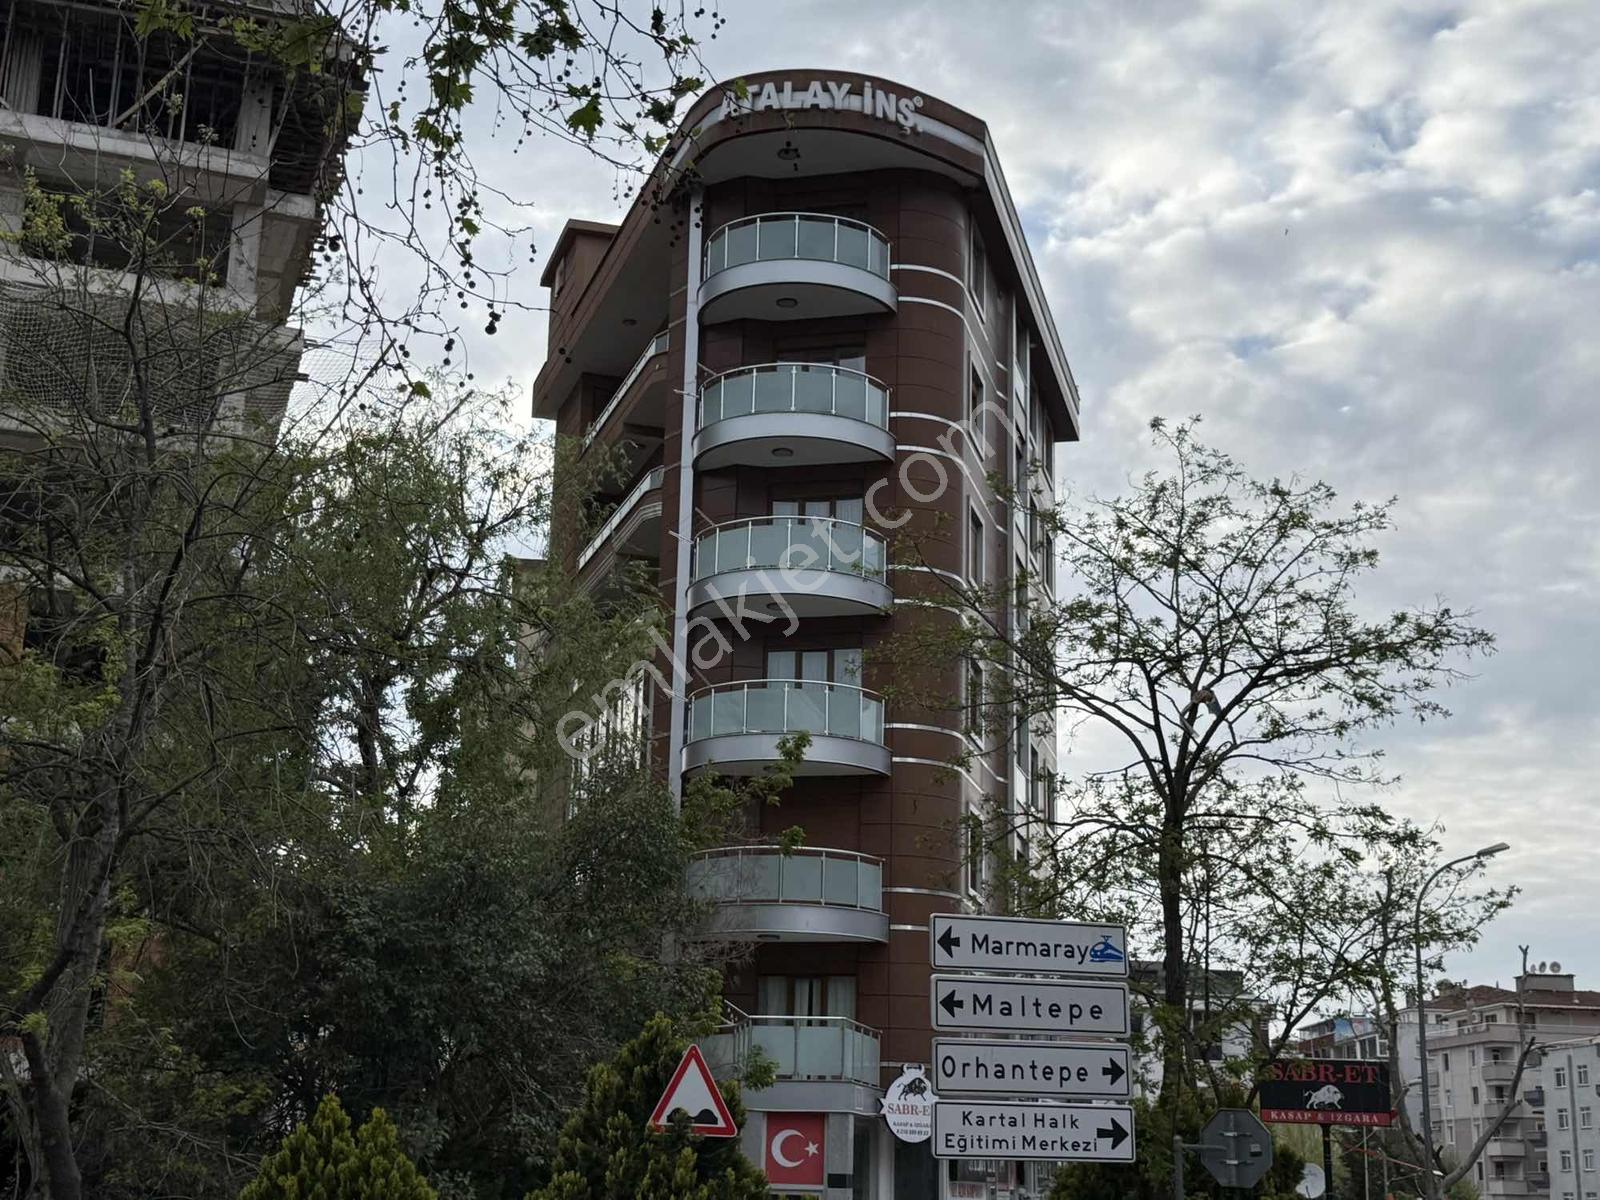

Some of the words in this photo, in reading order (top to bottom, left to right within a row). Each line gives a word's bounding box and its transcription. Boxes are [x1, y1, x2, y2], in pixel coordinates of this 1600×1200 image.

[719, 81, 852, 120] ATALAY
[972, 934, 1088, 964] Marmaray
[972, 994, 1103, 1025] Maltepe
[941, 1055, 1088, 1086] Orhantepe
[1271, 1062, 1378, 1083] SABR-ET
[887, 1102, 931, 1116] SABR-E
[1270, 1111, 1311, 1121] KASAP
[962, 1111, 1025, 1128] Kartal
[1034, 1113, 1079, 1129] Halk
[944, 1133, 1016, 1152] Eğitimi
[1022, 1135, 1098, 1152] Merkezi
